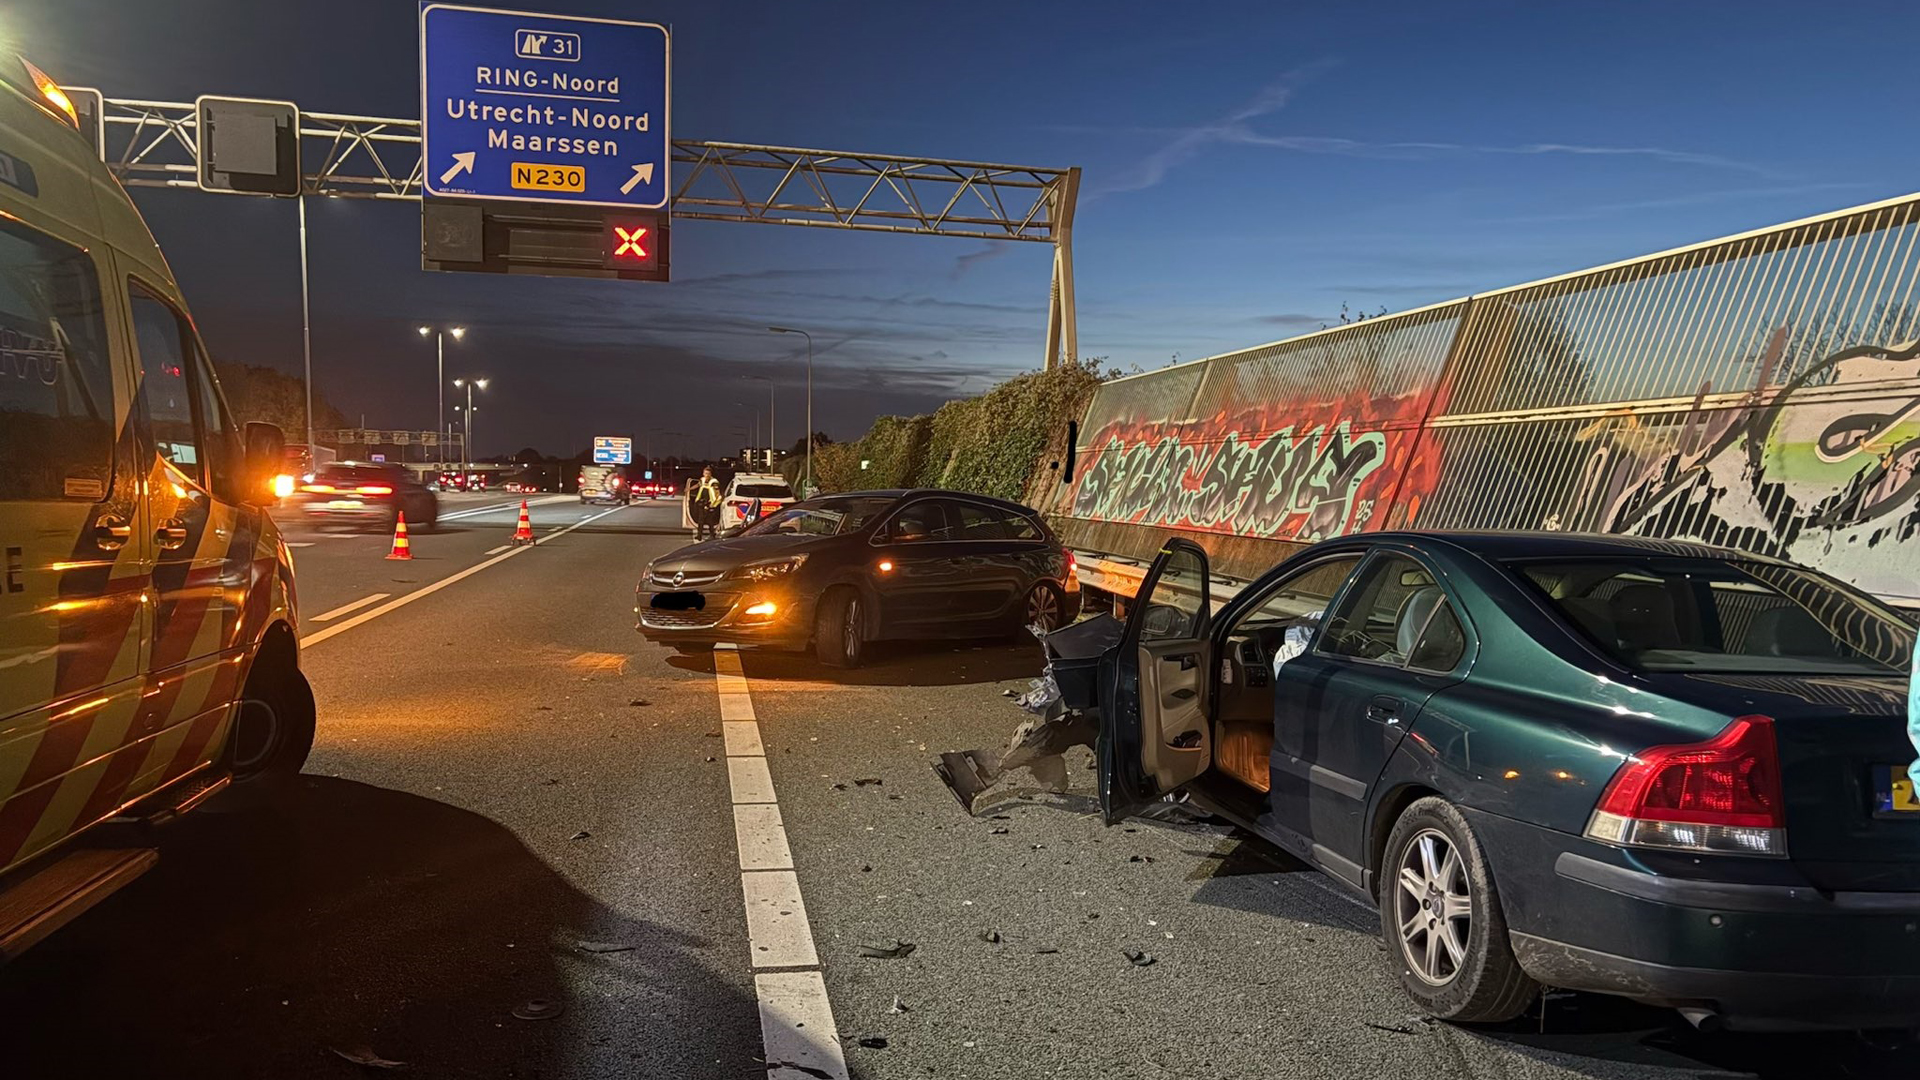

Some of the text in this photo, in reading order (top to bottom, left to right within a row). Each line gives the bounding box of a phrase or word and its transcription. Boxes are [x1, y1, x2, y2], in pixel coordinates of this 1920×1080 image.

[552, 39, 573, 55] 31
[476, 66, 620, 94] RING-Noord
[447, 98, 649, 132] Utrecht-Noord
[488, 129, 618, 156] Maarssen
[516, 167, 582, 187] N230
